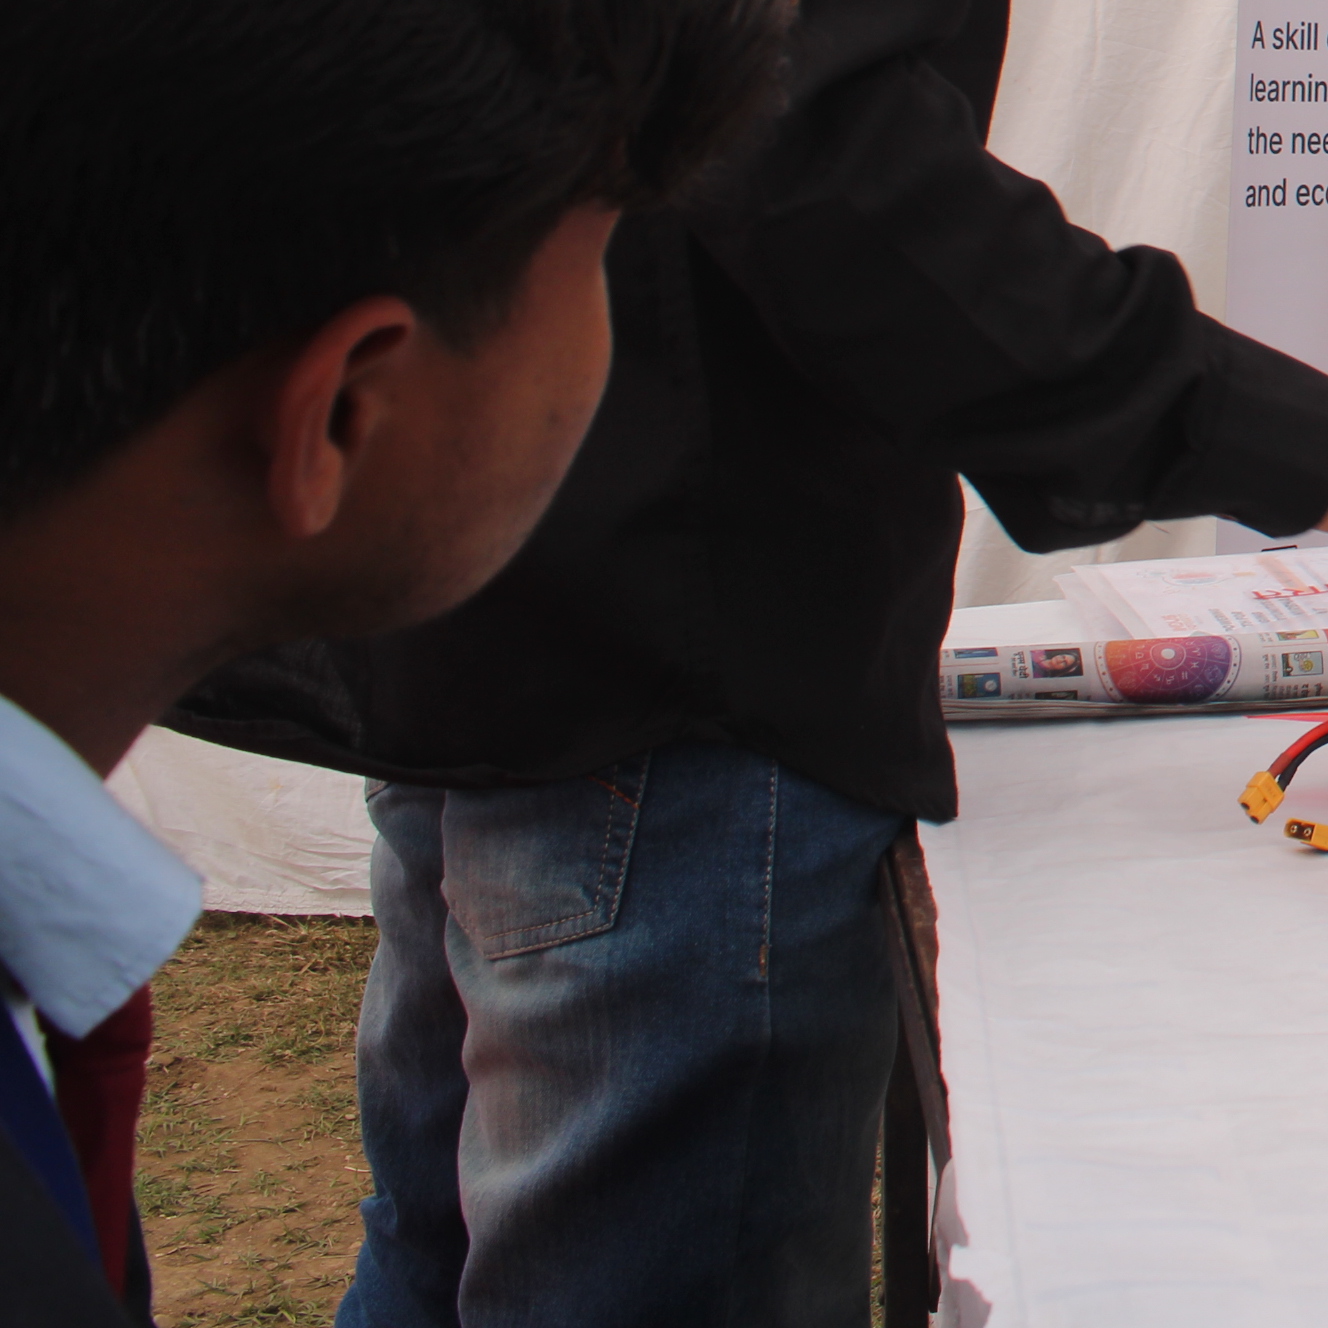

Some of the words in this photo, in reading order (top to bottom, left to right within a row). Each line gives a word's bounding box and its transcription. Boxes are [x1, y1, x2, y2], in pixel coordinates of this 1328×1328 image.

[1251, 21, 1266, 50] A
[1272, 22, 1319, 51] skill
[1247, 126, 1283, 154] the
[1245, 178, 1287, 207] and
